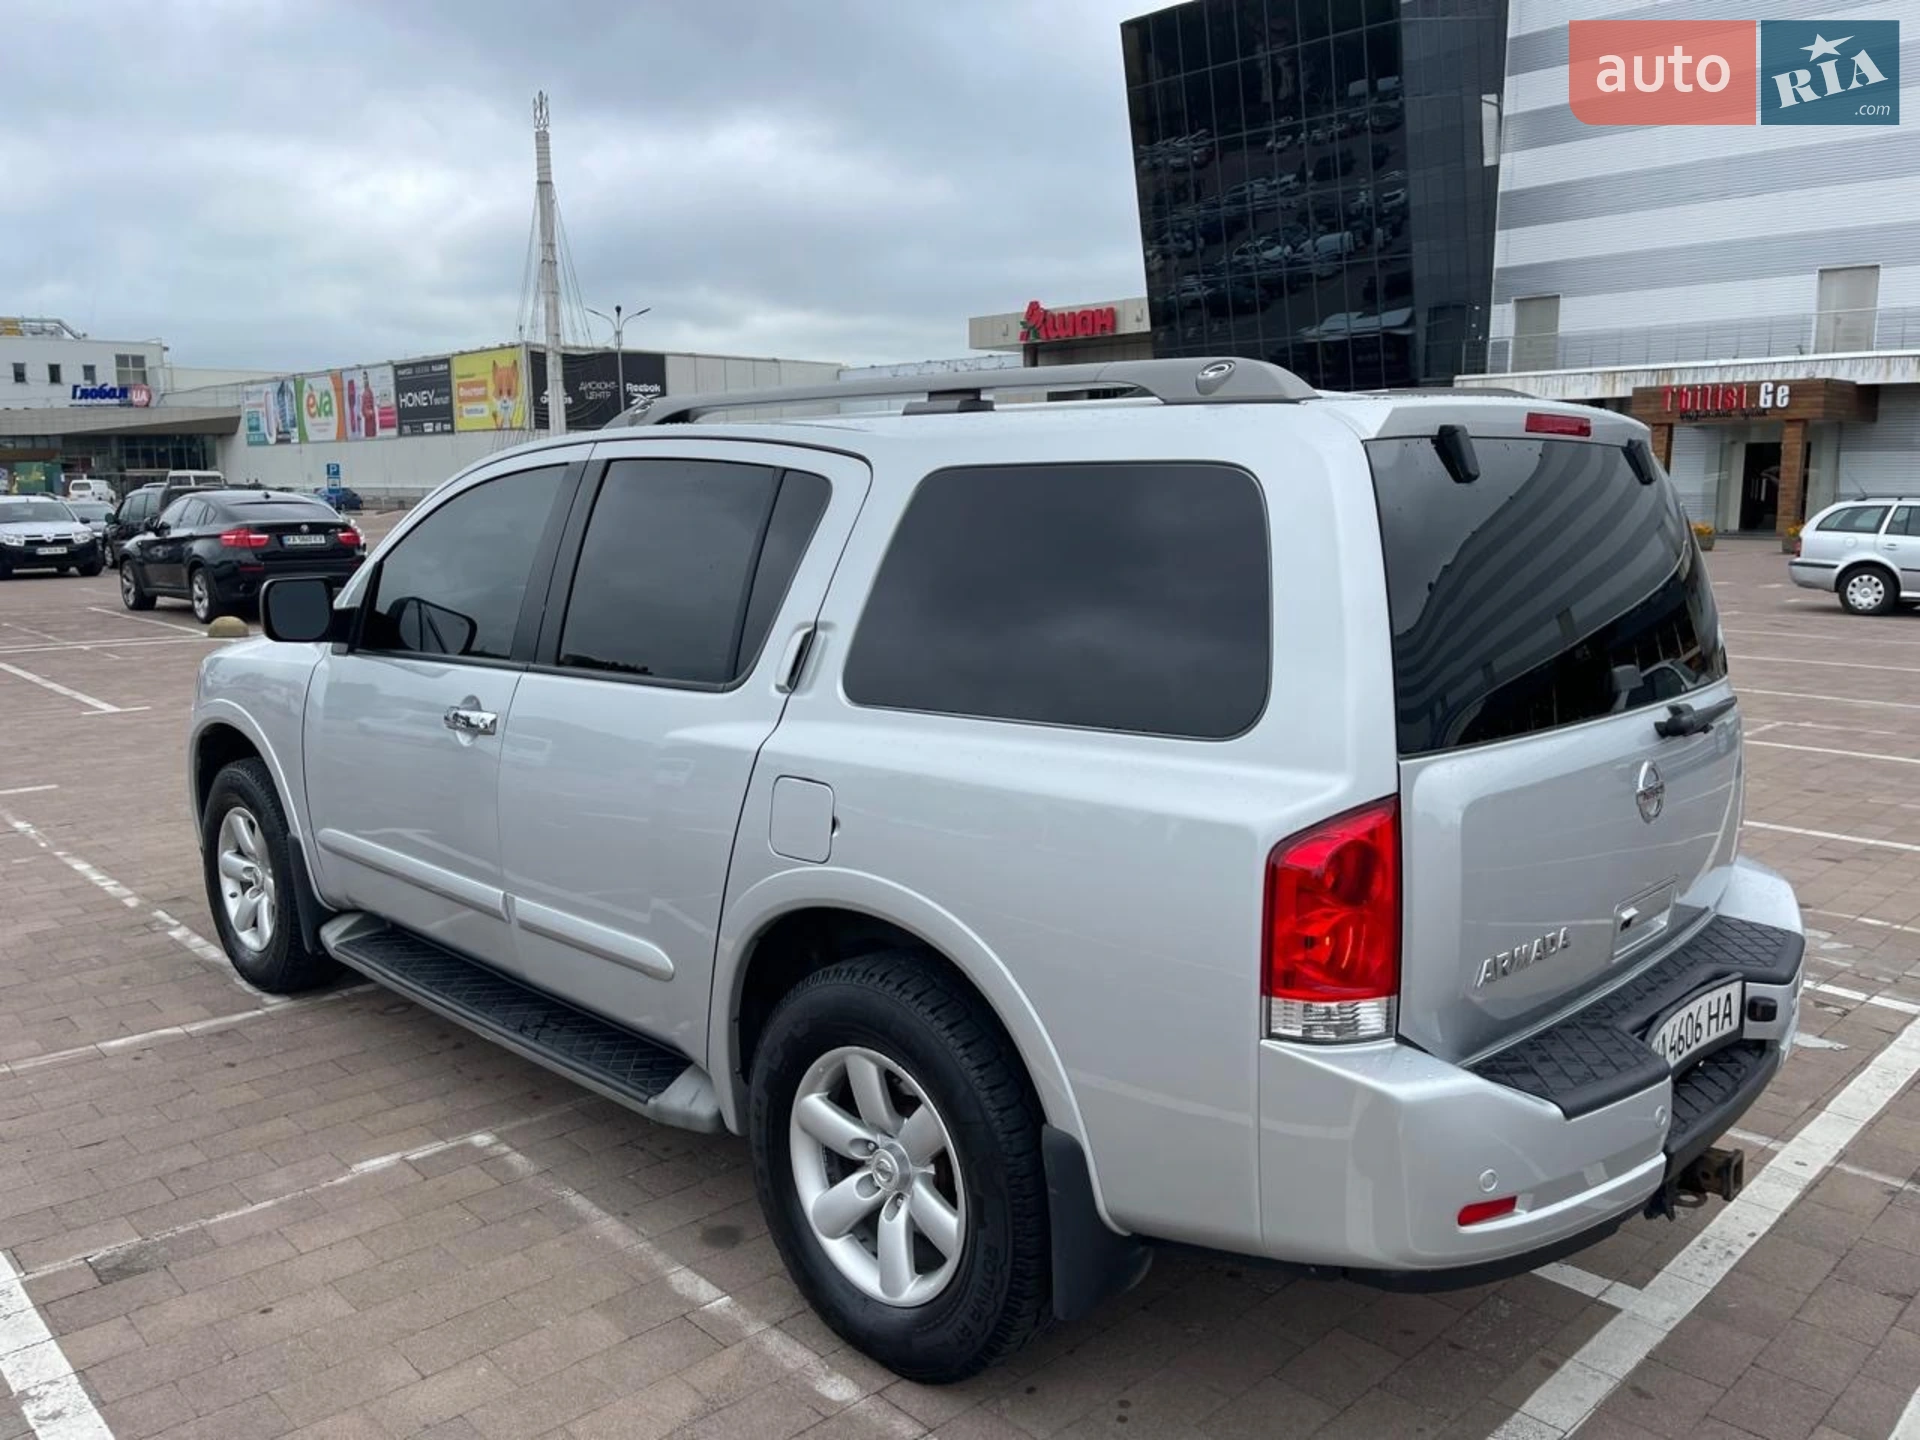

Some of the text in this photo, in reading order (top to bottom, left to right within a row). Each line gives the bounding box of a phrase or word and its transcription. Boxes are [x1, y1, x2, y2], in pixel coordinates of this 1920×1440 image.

[71, 382, 148, 402] Глобал UA
[626, 383, 661, 393] Reebok
[399, 389, 436, 408] HONEY
[329, 464, 338, 476] P
[1474, 926, 1571, 988] ARMADA
[1668, 1005, 1703, 1061] 4606
